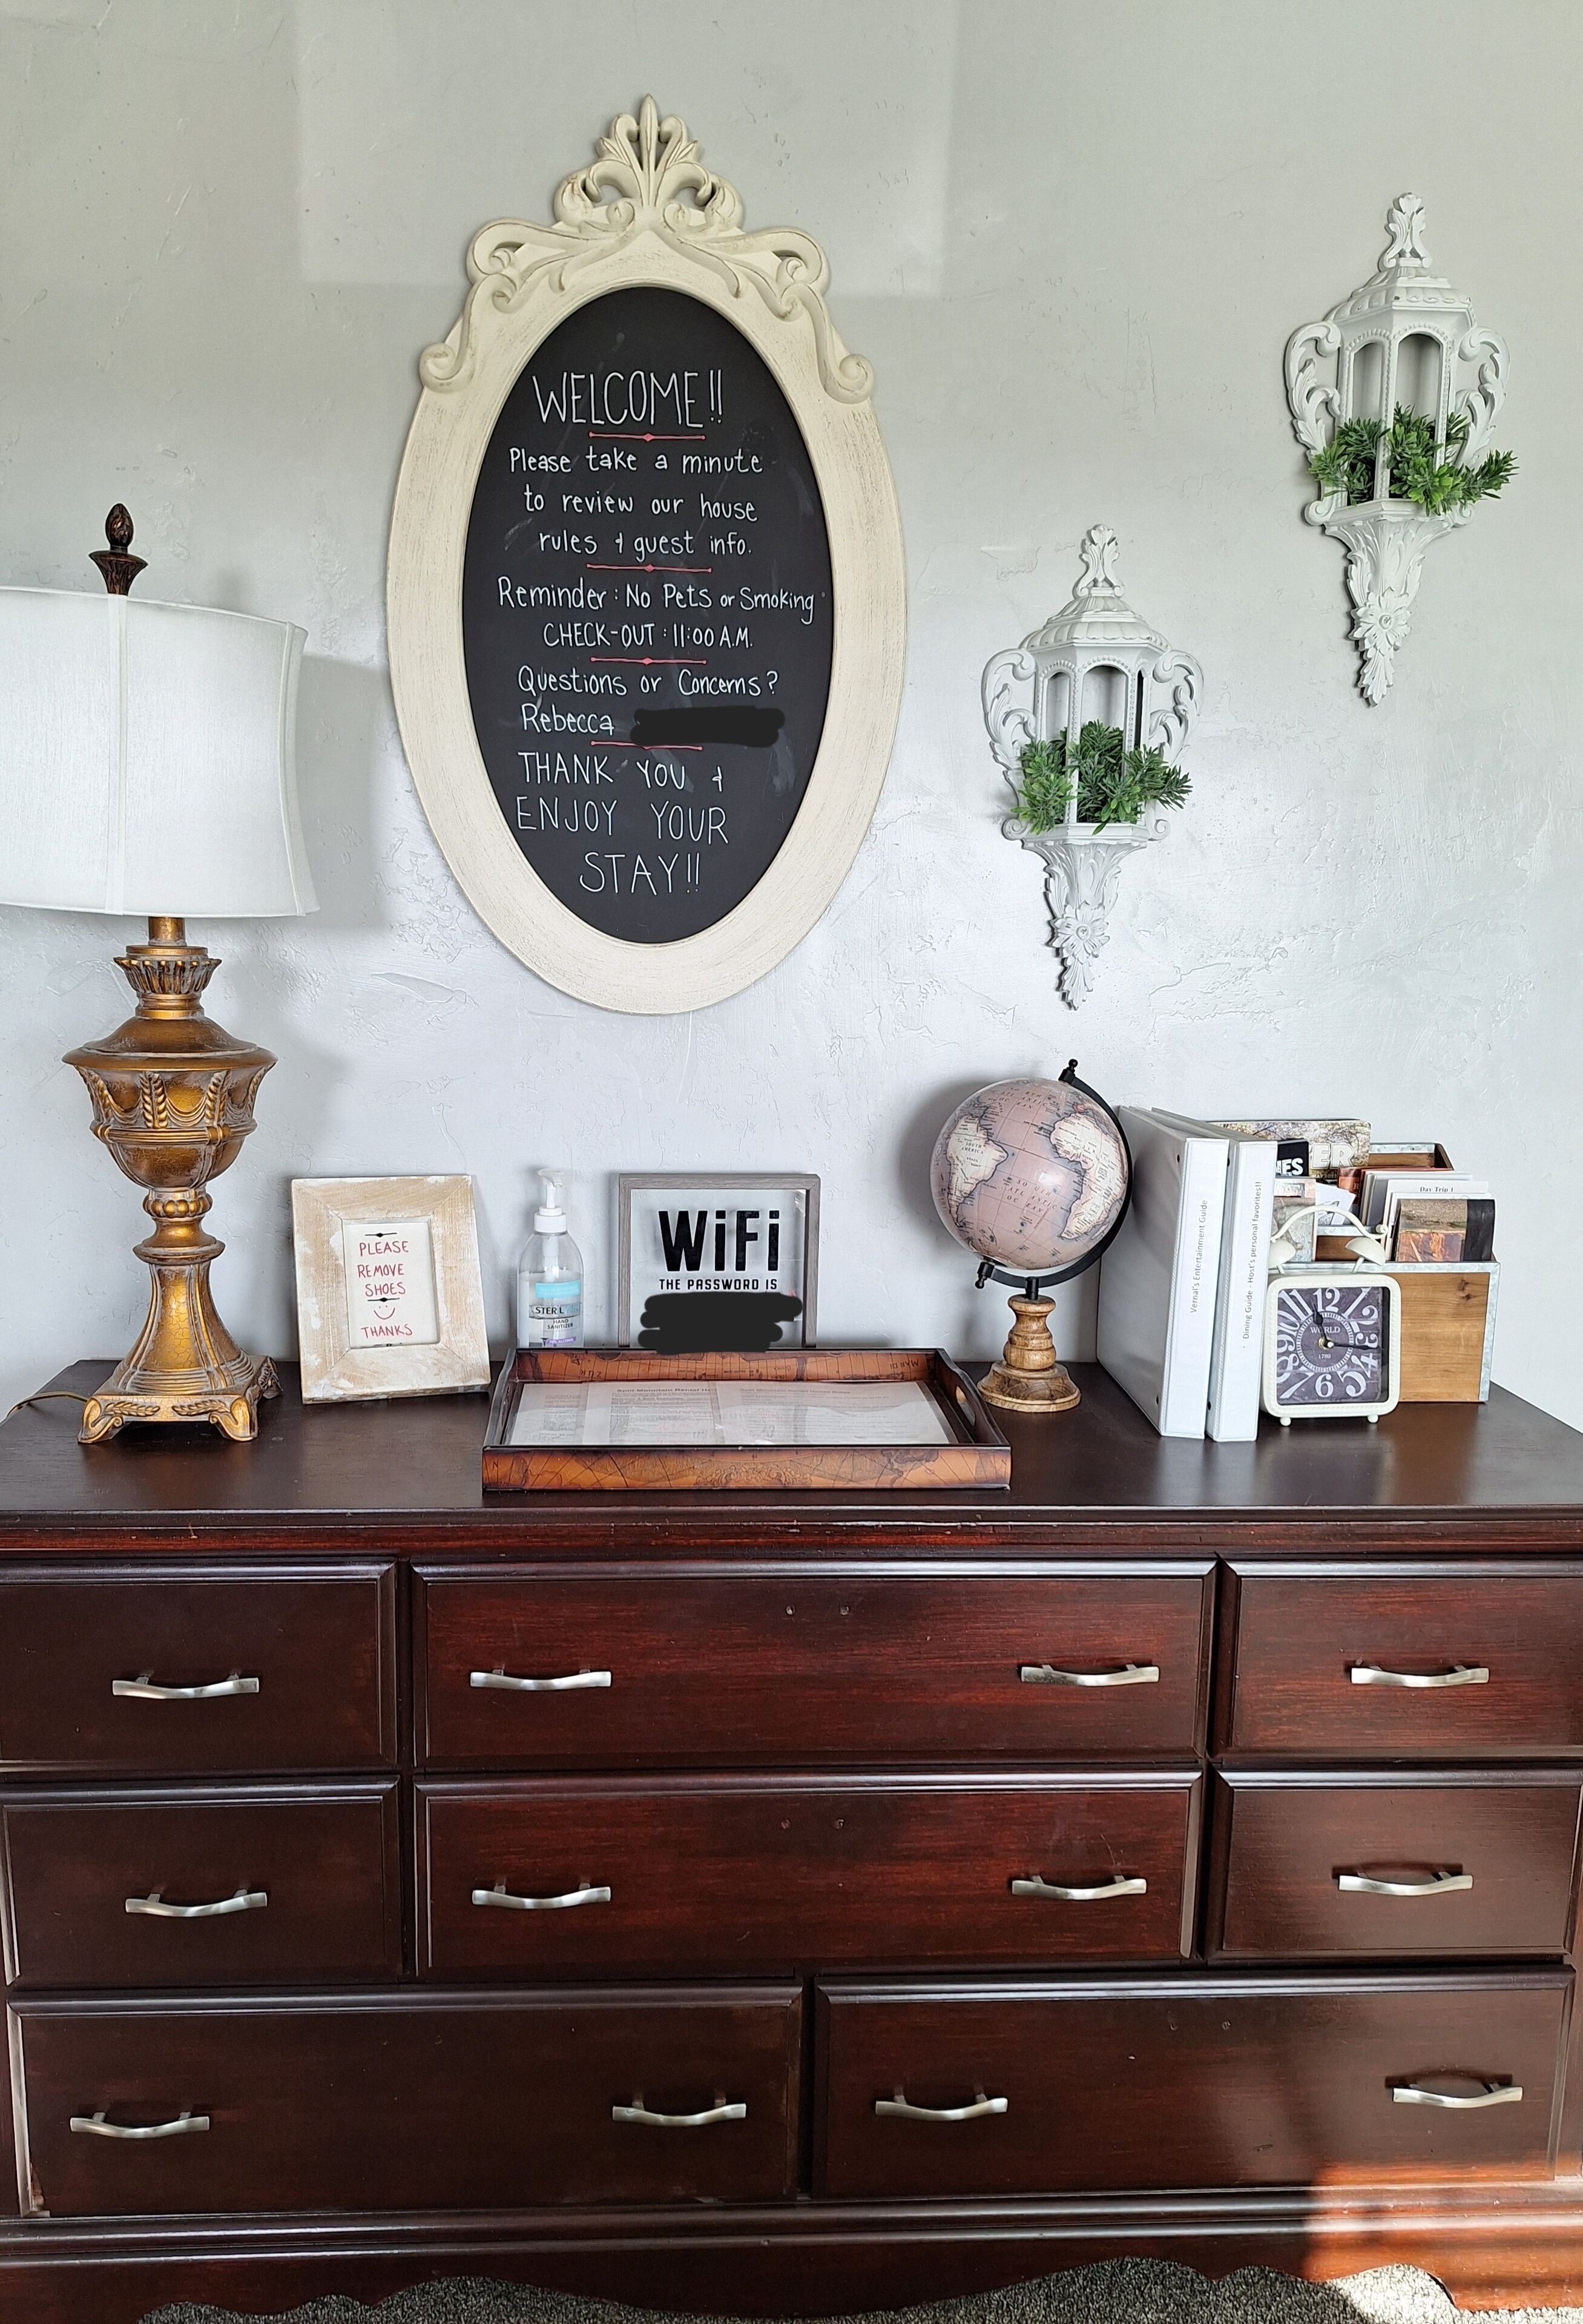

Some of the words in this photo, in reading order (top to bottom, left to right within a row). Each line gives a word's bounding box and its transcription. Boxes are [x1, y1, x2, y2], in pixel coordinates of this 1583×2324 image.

[532, 369, 722, 428] WELCOME!!
[510, 447, 571, 473] Please
[588, 445, 637, 471] take
[654, 455, 668, 470] a
[682, 448, 763, 474] minute
[524, 484, 544, 512] to
[562, 491, 633, 513] review
[651, 497, 684, 515] our
[700, 493, 757, 522] house
[539, 530, 597, 554] rules
[634, 530, 694, 562] guest
[710, 532, 752, 555] info.
[626, 583, 651, 608] No
[663, 583, 713, 608] Pets
[720, 594, 736, 607] or
[740, 586, 814, 625] Smoking
[673, 623, 714, 648] 11:00
[518, 665, 627, 697] Questions
[640, 675, 662, 693] or
[521, 703, 614, 736] Rebecca
[518, 752, 613, 784] THANK
[636, 760, 685, 790] YOU
[516, 796, 617, 836] ENJOY
[650, 800, 728, 845] YOUR
[579, 852, 700, 896] STAY!!
[1199, 1200, 1208, 1223] Guide
[359, 1241, 409, 1257] PLEASE
[658, 1210, 780, 1272] WiFi
[1193, 1225, 1205, 1281] Entertainment
[357, 1263, 404, 1278] REMOVE
[659, 1279, 681, 1290] THE
[688, 1279, 759, 1290] PASSWORD
[766, 1279, 777, 1290] IS
[1243, 1315, 1252, 1339] Dining
[1250, 1224, 1259, 1258] personal
[364, 1282, 406, 1298] SHOES
[1190, 1282, 1199, 1313] Vernal's
[1278, 1288, 1313, 1322] 11
[1312, 1288, 1340, 1312] 12
[1341, 1287, 1372, 1319] 1
[360, 1324, 413, 1339] THANKS
[1349, 1305, 1378, 1333] 2
[1277, 1333, 1295, 1353] 9
[1355, 1333, 1378, 1349] 3
[1277, 1353, 1300, 1384] 8
[1337, 1365, 1367, 1397] 5
[1351, 1353, 1378, 1379] 4
[1279, 1366, 1315, 1399] 7
[1315, 1373, 1334, 1397] 6
